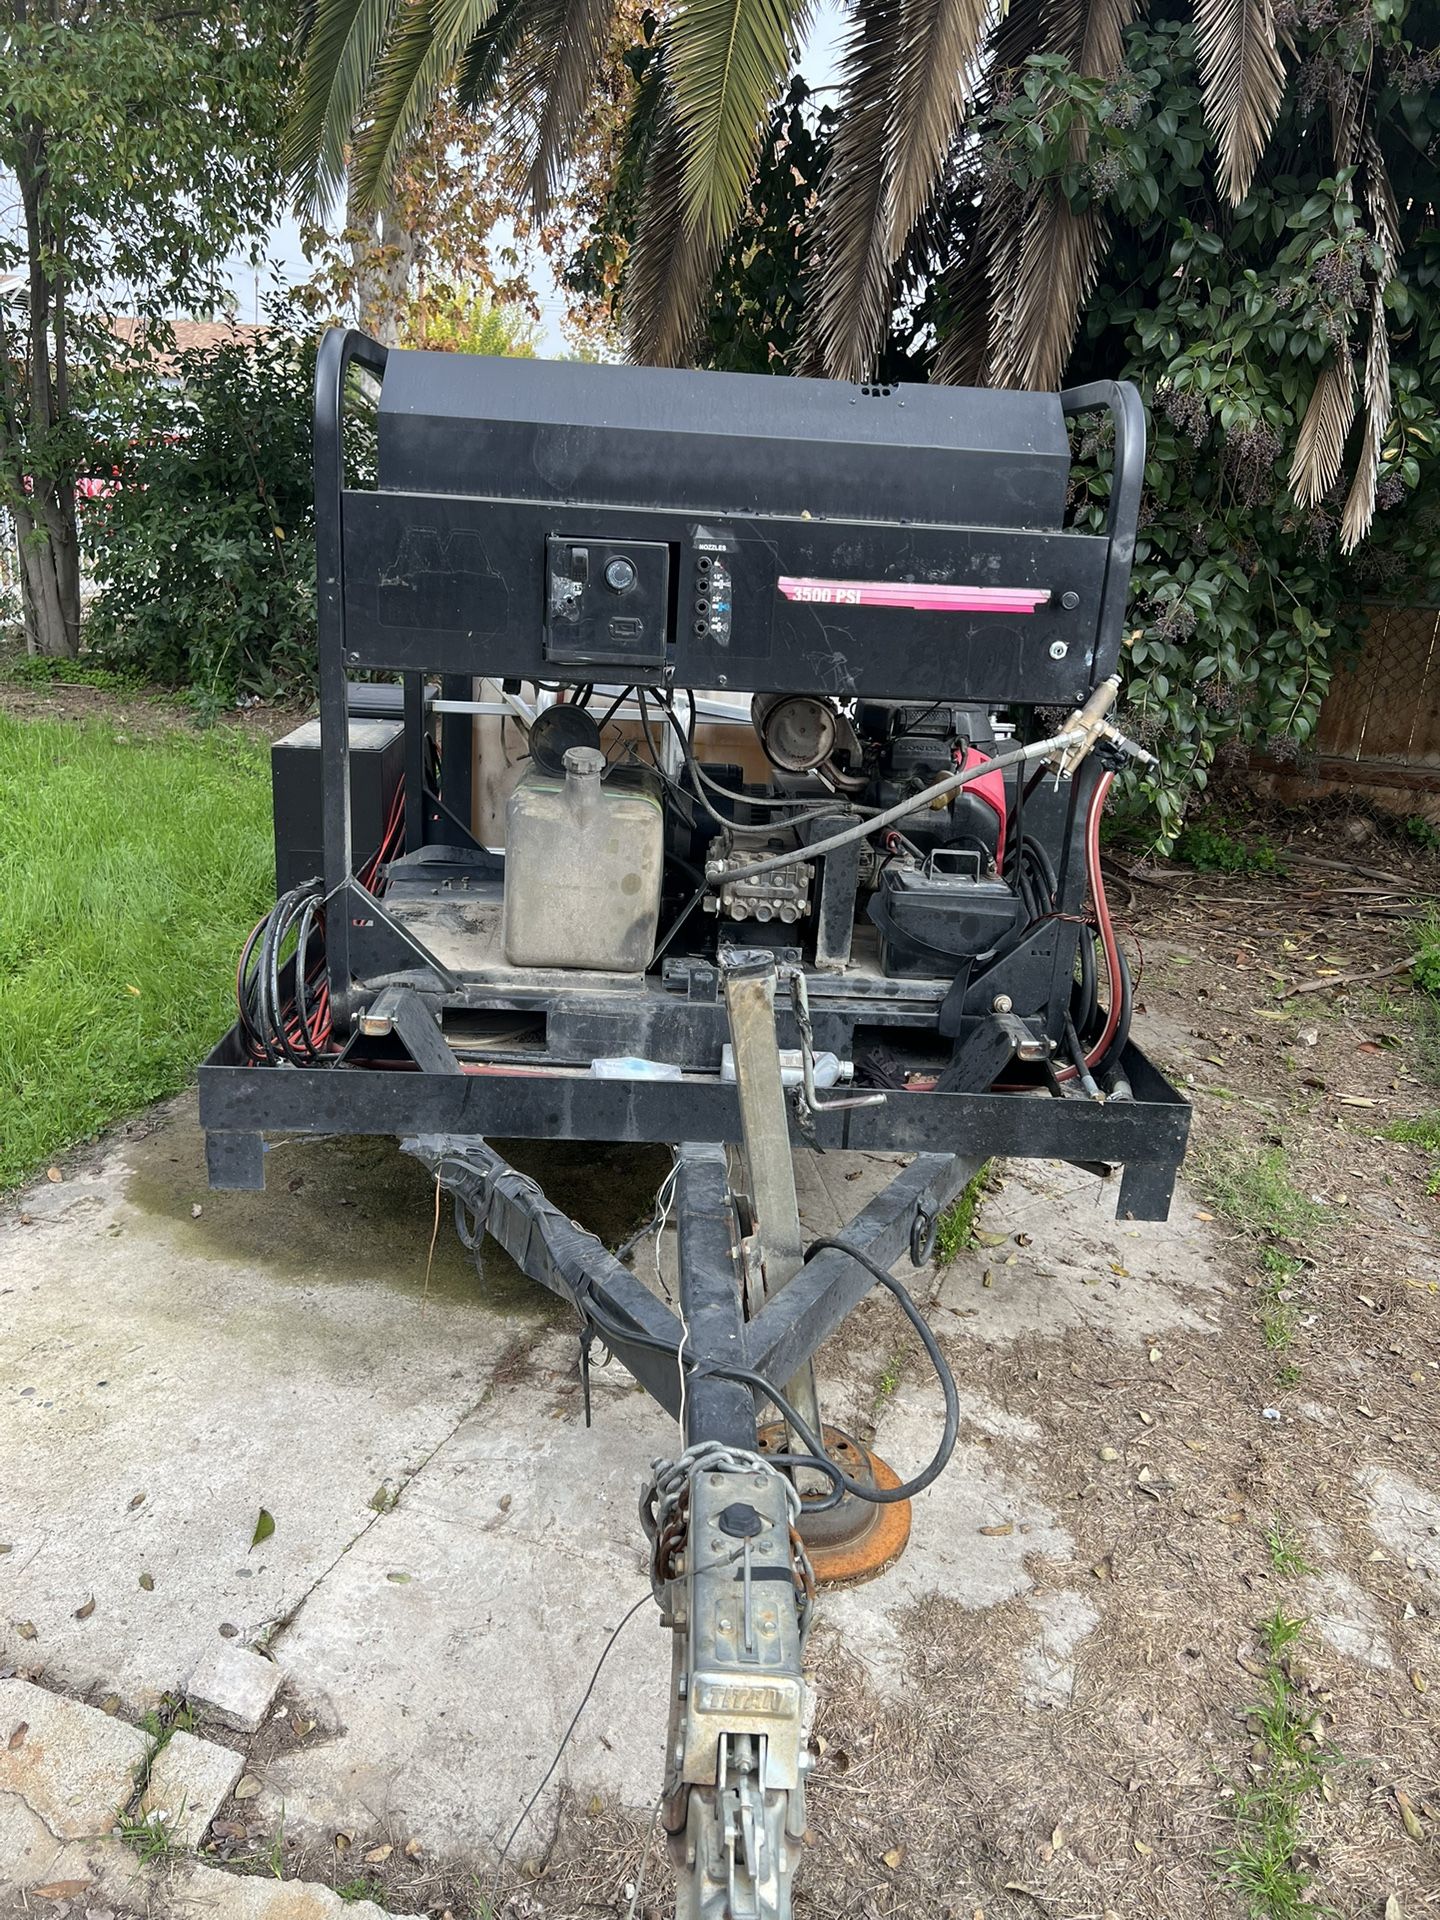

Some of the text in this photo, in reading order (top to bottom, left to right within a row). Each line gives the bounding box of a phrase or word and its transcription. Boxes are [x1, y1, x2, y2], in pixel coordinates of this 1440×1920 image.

[793, 586, 861, 604] 3500 PSI
[709, 1686, 786, 1712] TITAN
